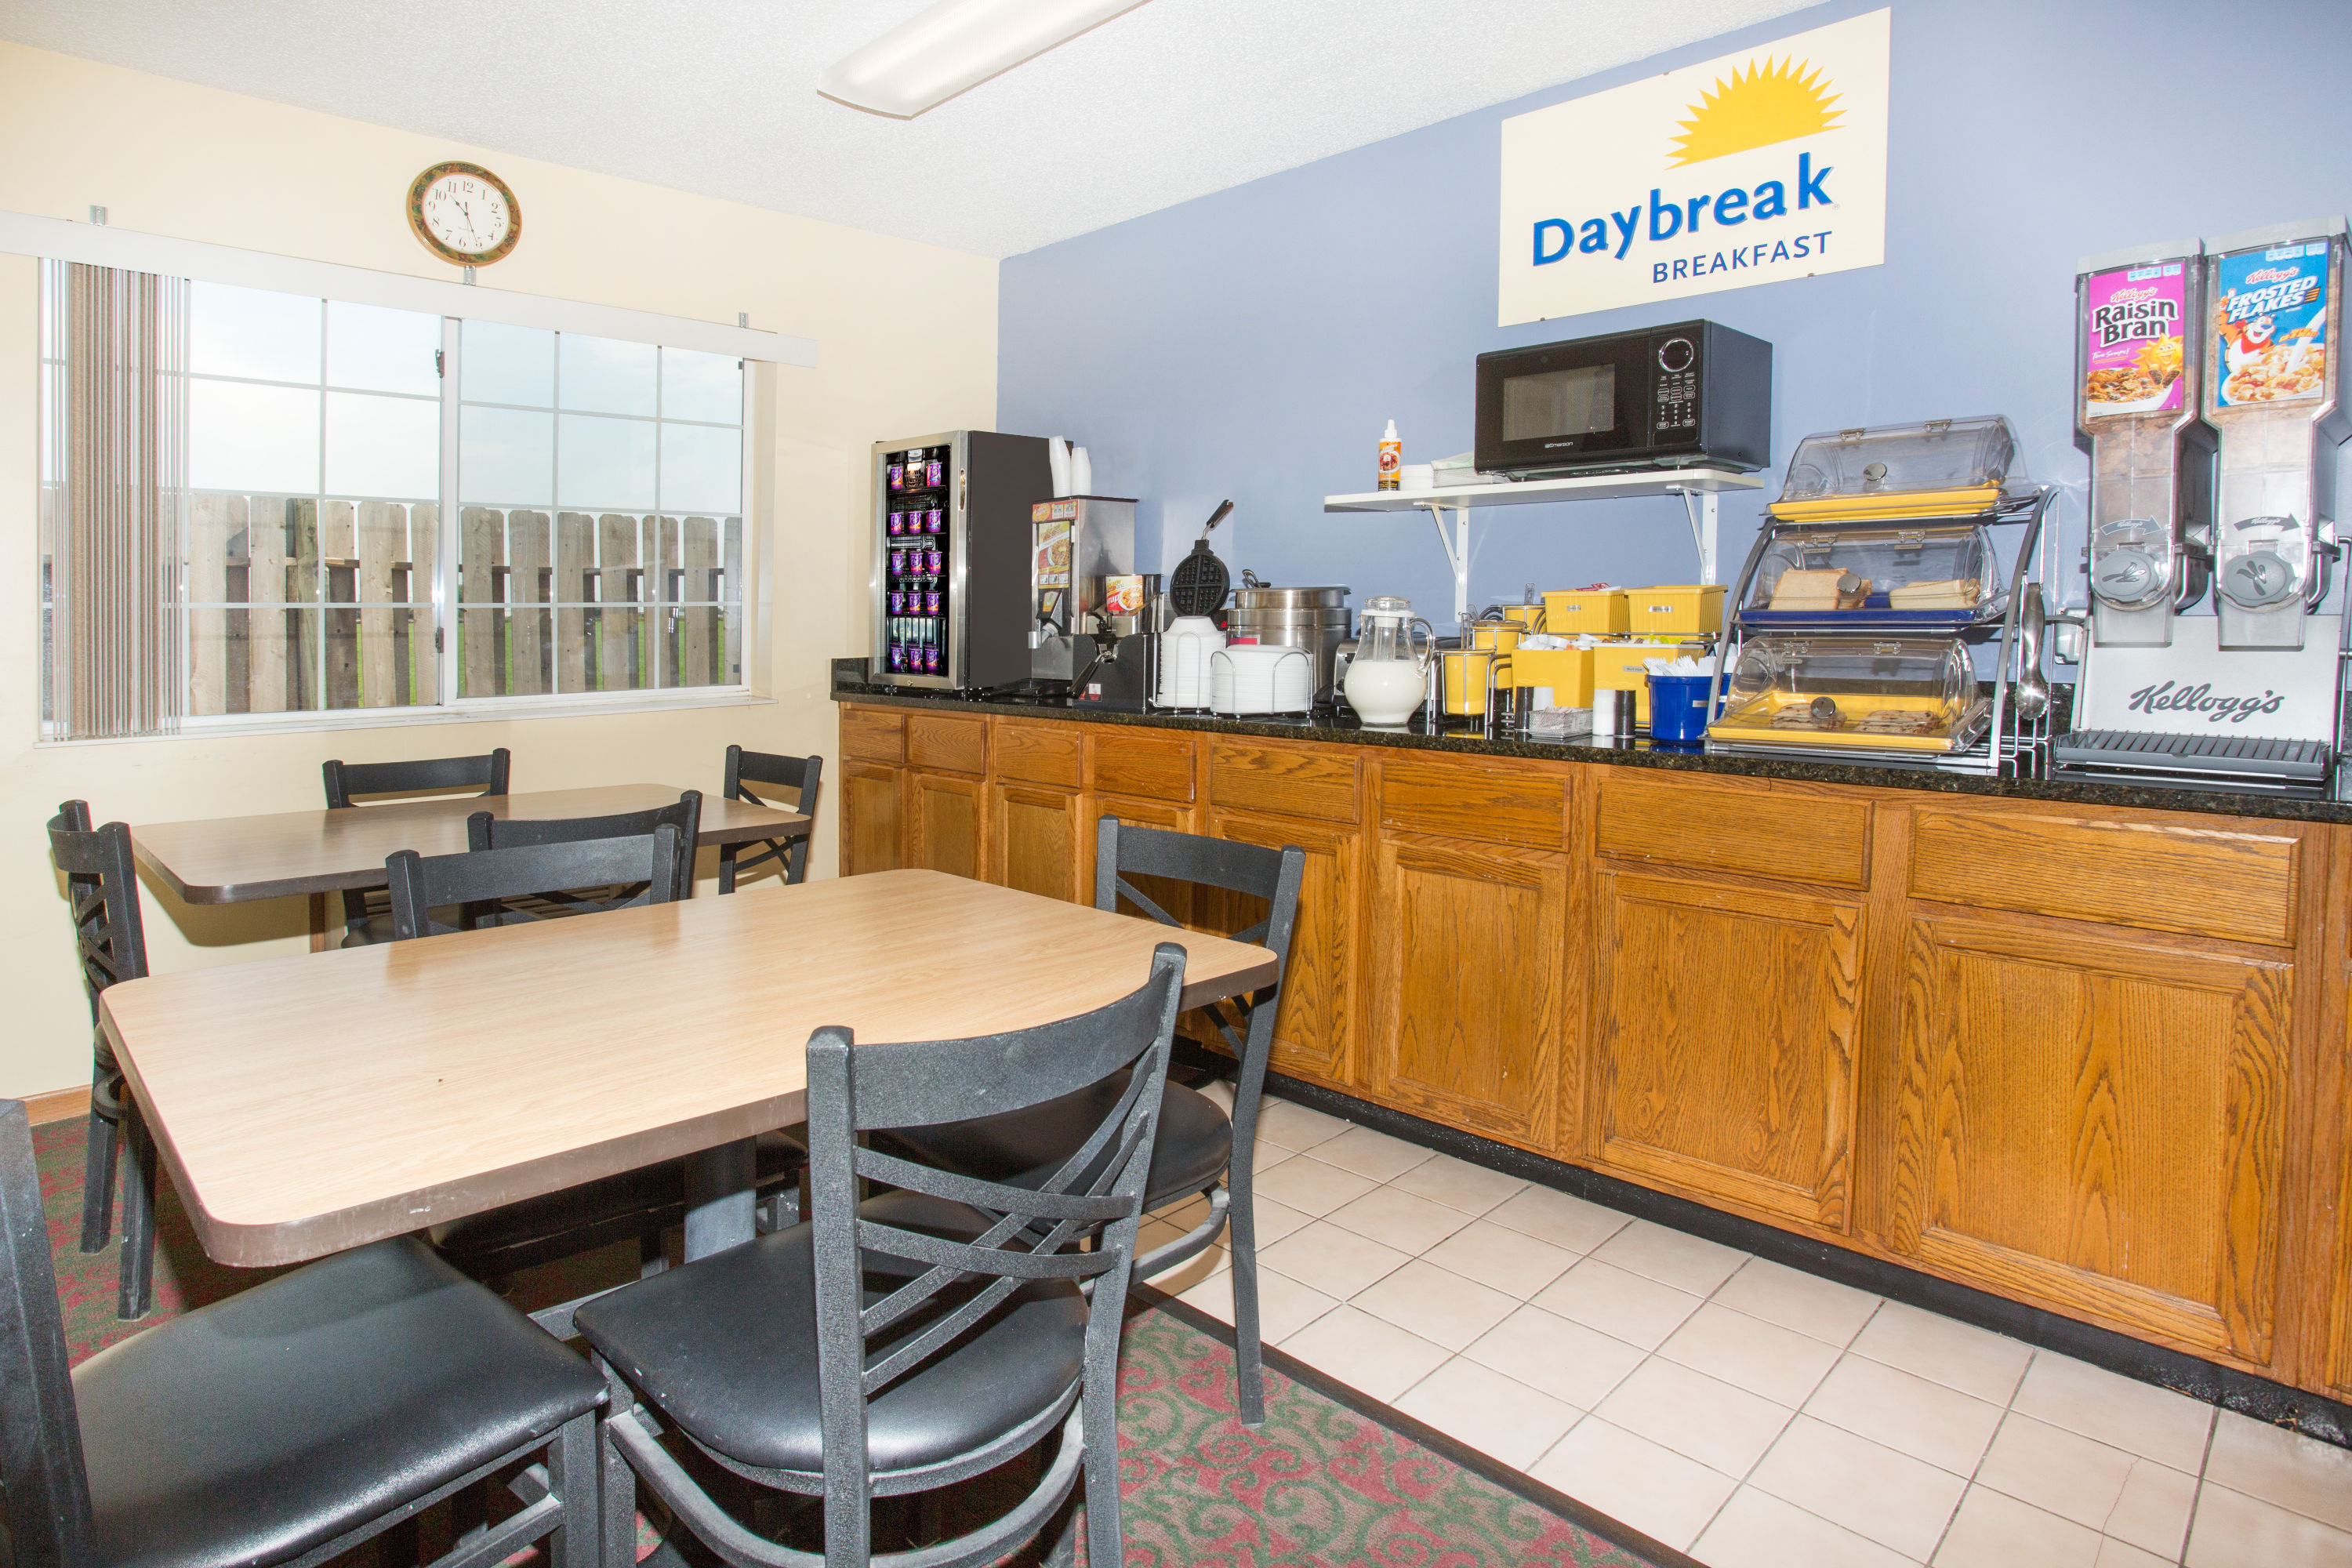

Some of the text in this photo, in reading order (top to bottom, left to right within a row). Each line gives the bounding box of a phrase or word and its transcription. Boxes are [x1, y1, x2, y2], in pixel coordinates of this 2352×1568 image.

[448, 181, 457, 194] 11
[463, 180, 474, 194] 12
[434, 188, 447, 201] 10
[481, 189, 487, 200] 1
[428, 201, 436, 211] 9
[491, 202, 499, 214] 2
[1533, 151, 1834, 267] Daybreak
[432, 216, 440, 227] 8
[495, 216, 502, 228] 3
[445, 229, 452, 241] 7
[488, 232, 494, 241] 4
[459, 238, 466, 248] 6
[475, 238, 482, 249] 5
[1653, 230, 1833, 284] BREAKFAST
[2245, 267, 2299, 284] Kellogg's
[2111, 287, 2158, 303] Kellogg's
[2227, 275, 2318, 312] FROSTED
[2227, 291, 2305, 324] FLAKES
[2095, 300, 2176, 329] Raisin
[2103, 320, 2166, 345] Bran
[1106, 595, 1120, 604] rup
[2128, 680, 2285, 723] Kellogg's
